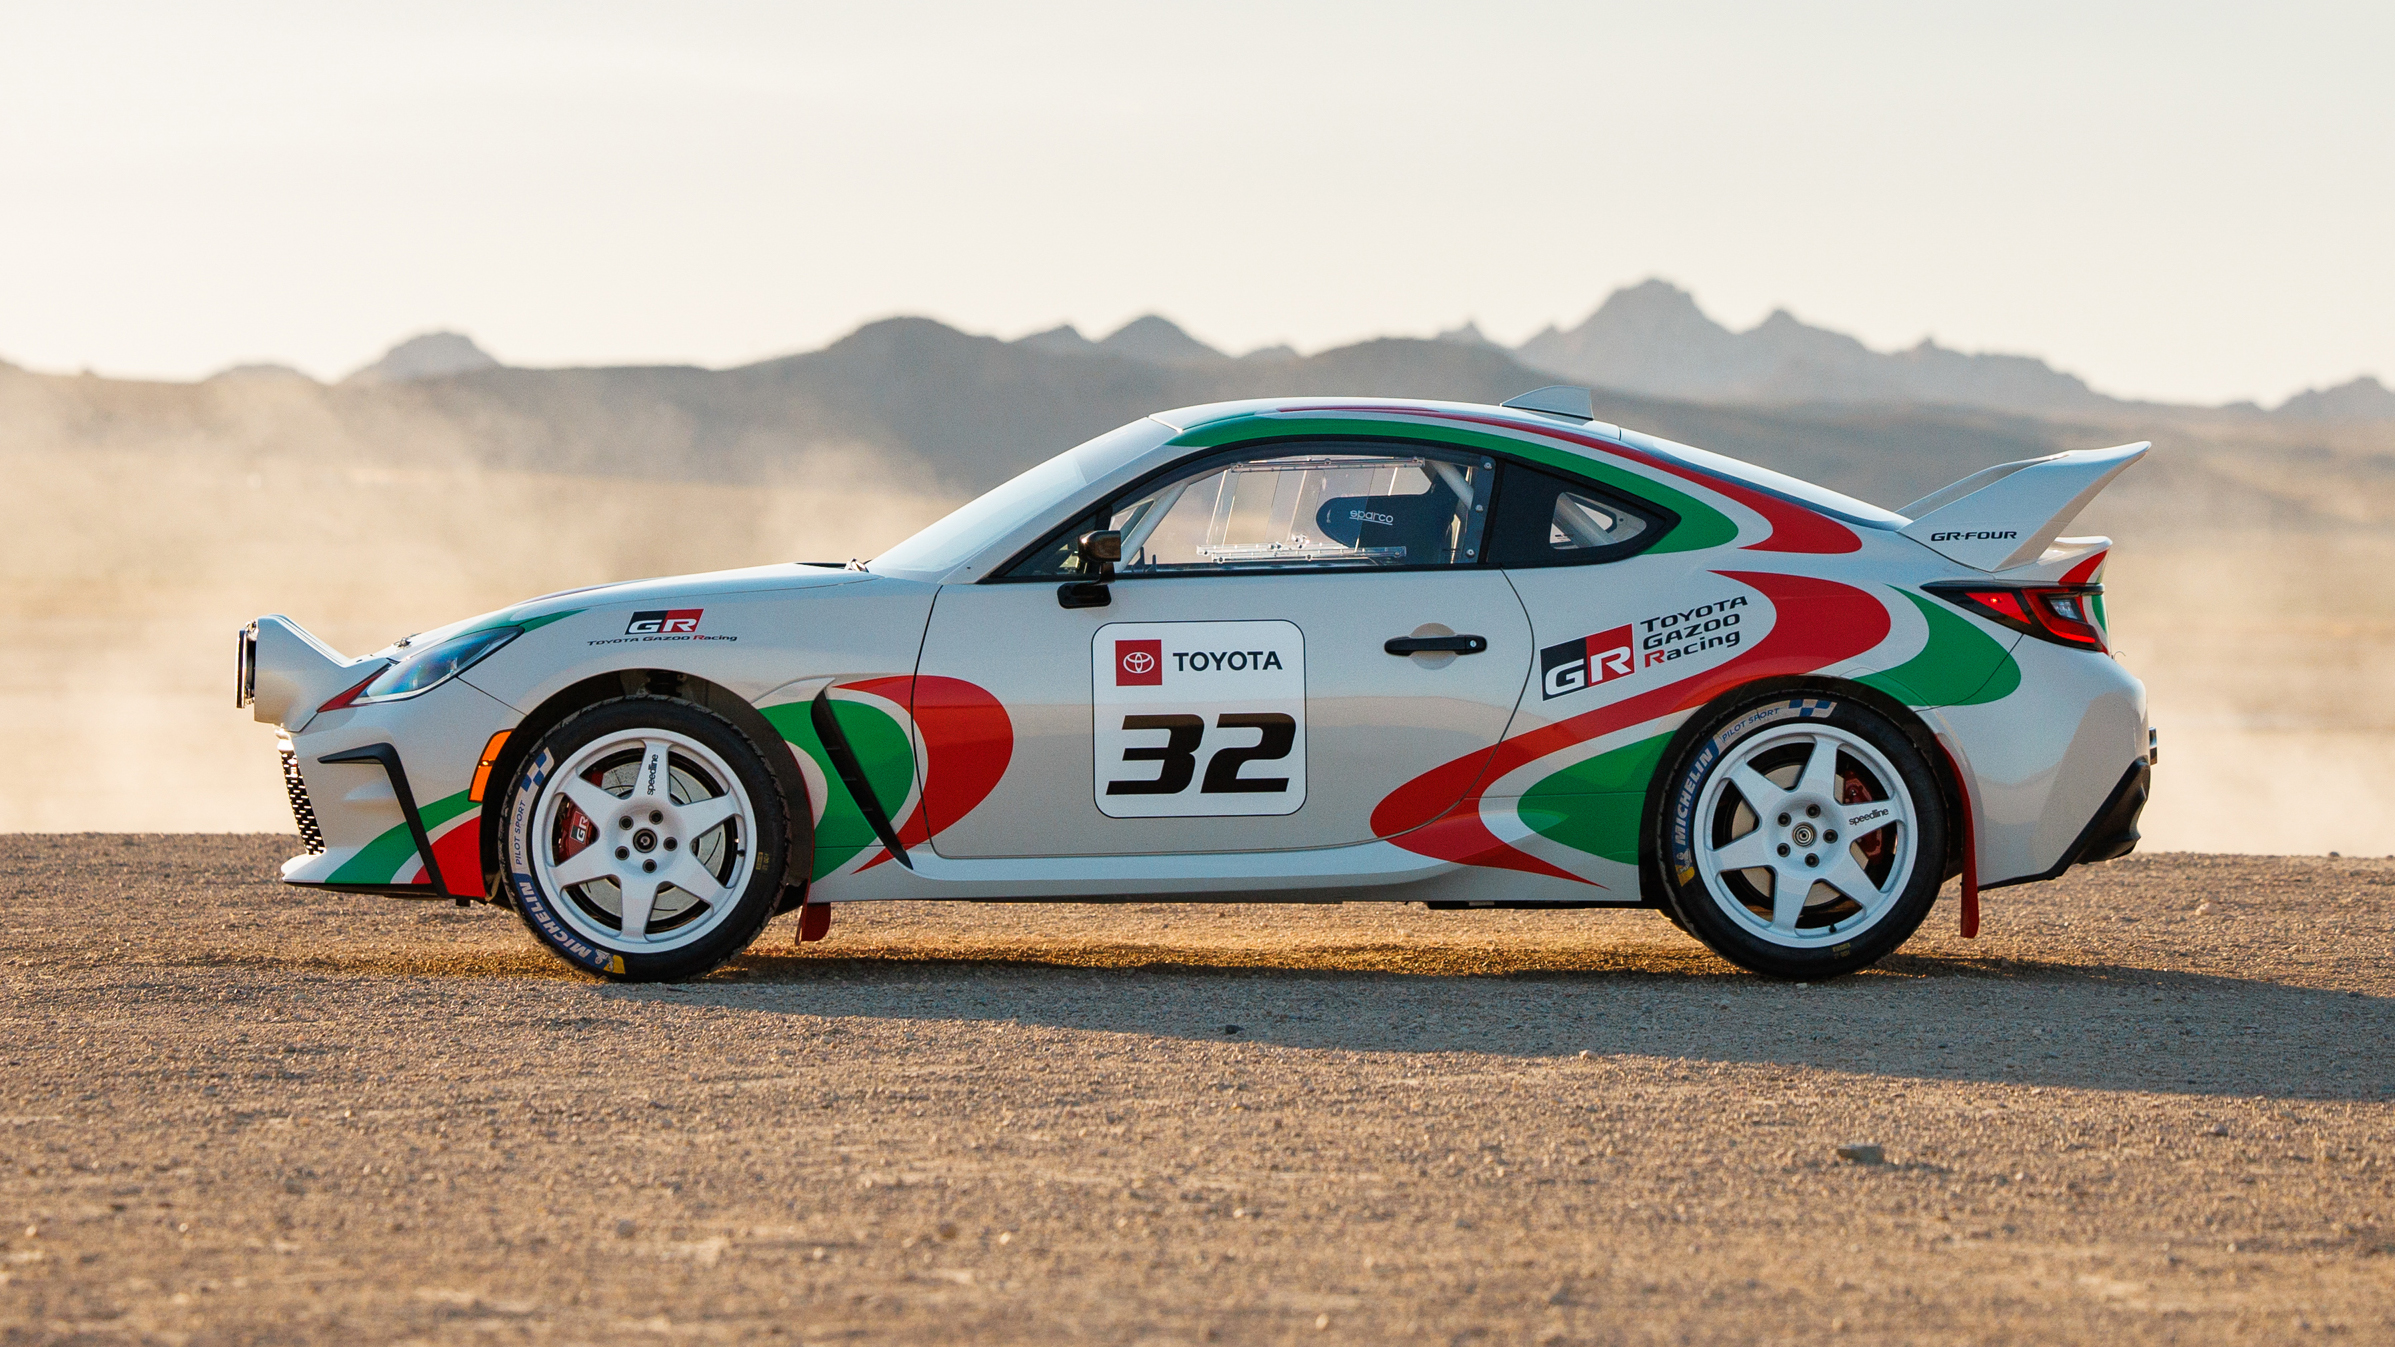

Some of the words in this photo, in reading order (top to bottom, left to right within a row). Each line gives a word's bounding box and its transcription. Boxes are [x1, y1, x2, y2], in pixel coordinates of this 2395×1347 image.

[1349, 509, 1394, 525] sparco
[628, 618, 697, 634] GR
[1639, 595, 1748, 633] TOYOTA
[1642, 613, 1740, 650] GAZOO
[587, 637, 639, 646] TOYOTA
[693, 634, 738, 642] Racing
[1644, 630, 1740, 668] Racing
[1172, 650, 1283, 672] TOYOTA
[1545, 645, 1632, 696] GR
[1721, 720, 1746, 742] PILOT
[1748, 707, 1780, 725] SPORT
[1106, 712, 1297, 795] 32
[647, 754, 659, 795] speedline
[1675, 749, 1714, 846] MICHELIN
[515, 800, 526, 834] SPORT
[575, 815, 589, 842] GR
[1848, 808, 1889, 826] speedline
[514, 834, 523, 866] PILOT
[519, 882, 591, 959] MICHELIN
